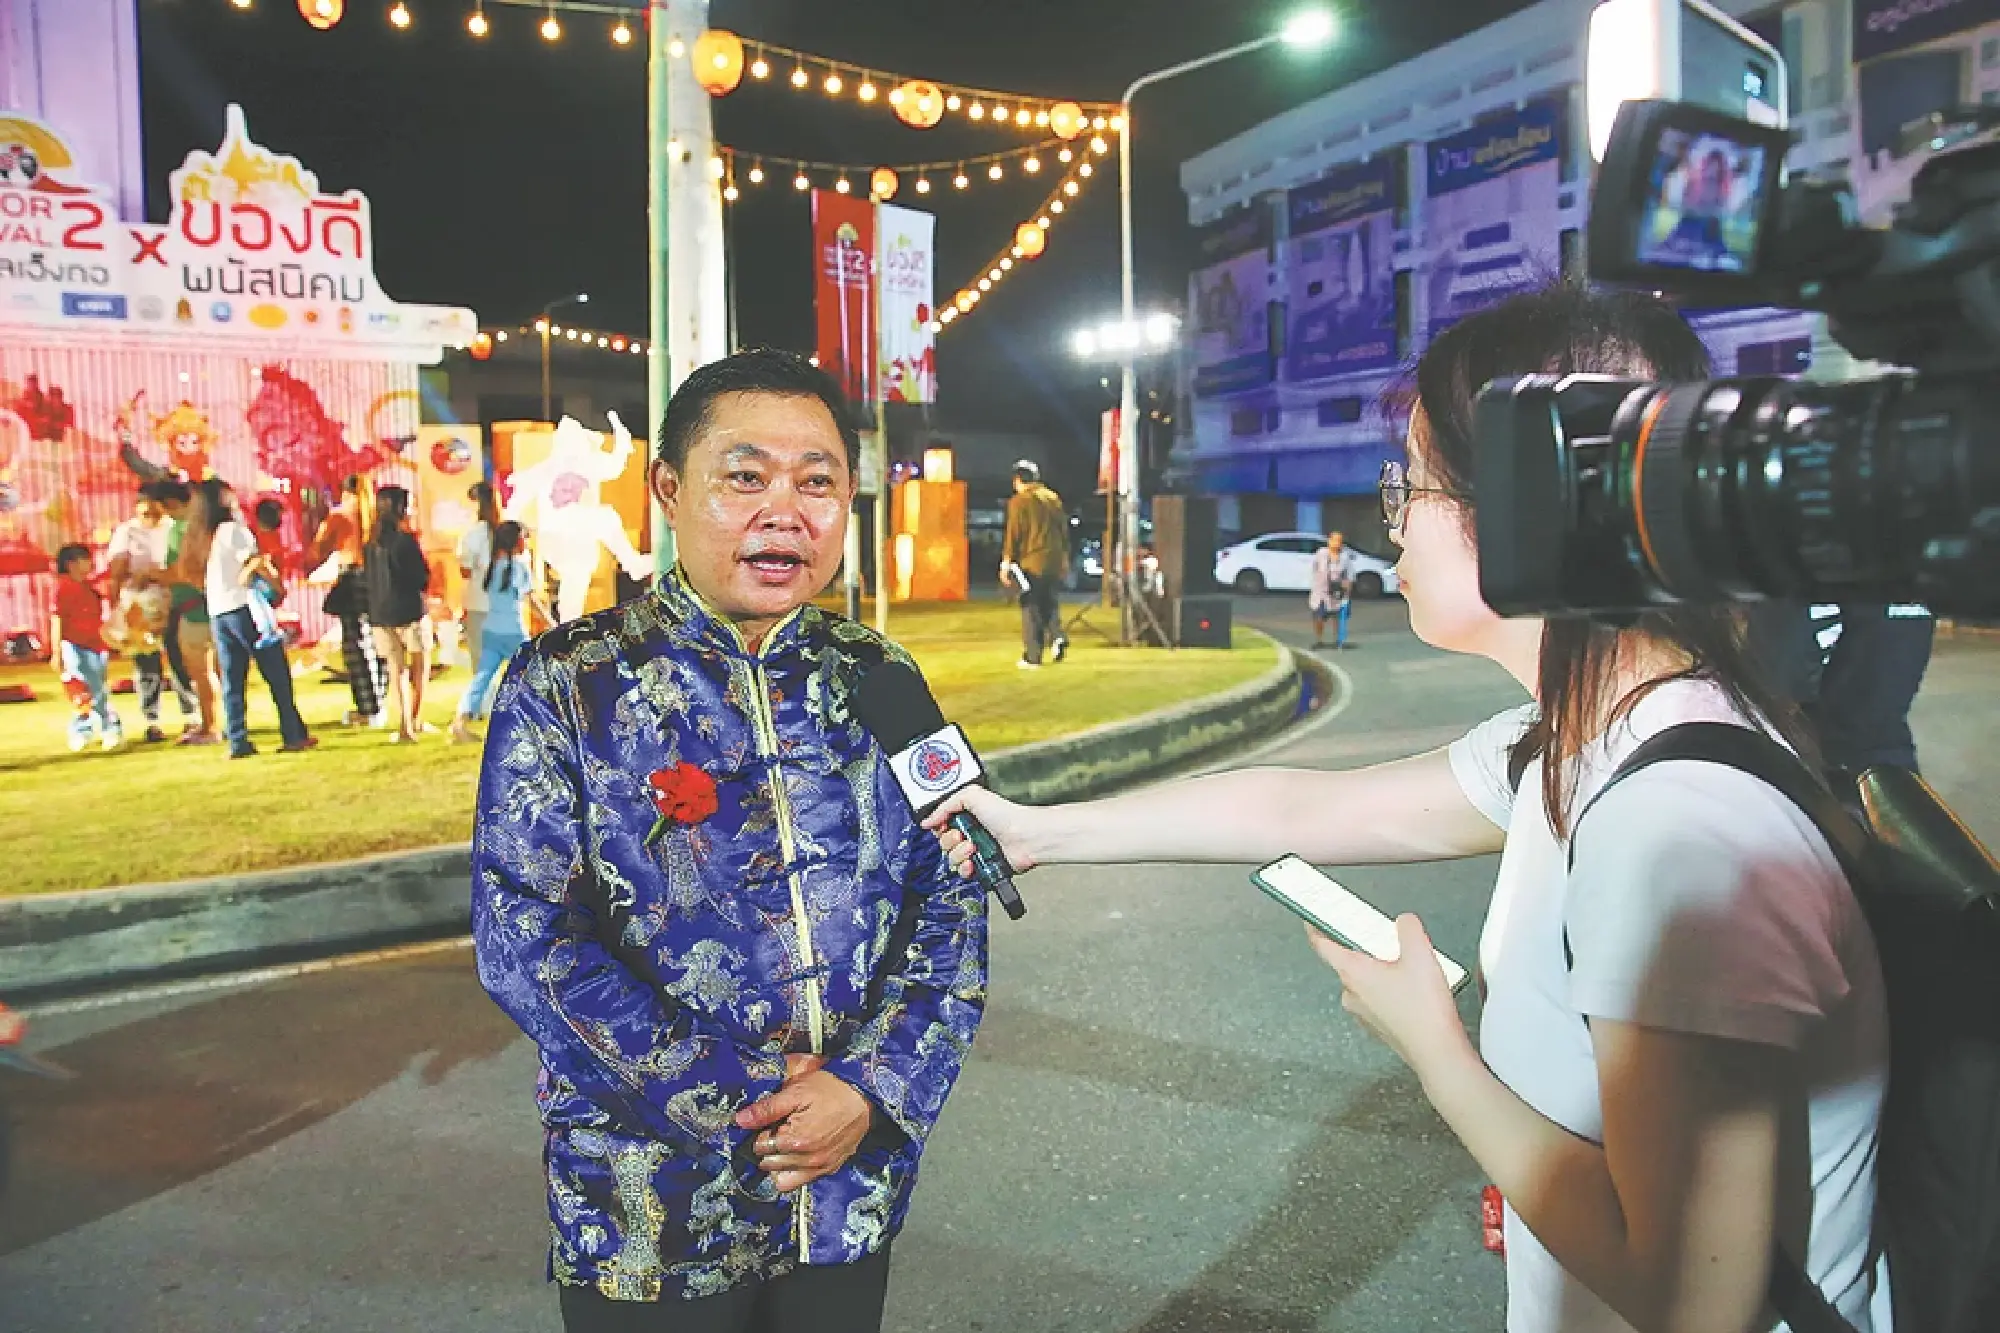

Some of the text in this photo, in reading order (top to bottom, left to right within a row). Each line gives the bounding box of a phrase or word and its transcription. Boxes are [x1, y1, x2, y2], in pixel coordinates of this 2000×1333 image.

[61, 201, 104, 250] 2
[181, 198, 363, 259] ของดี
[182, 255, 364, 302] พนัสนิคม
